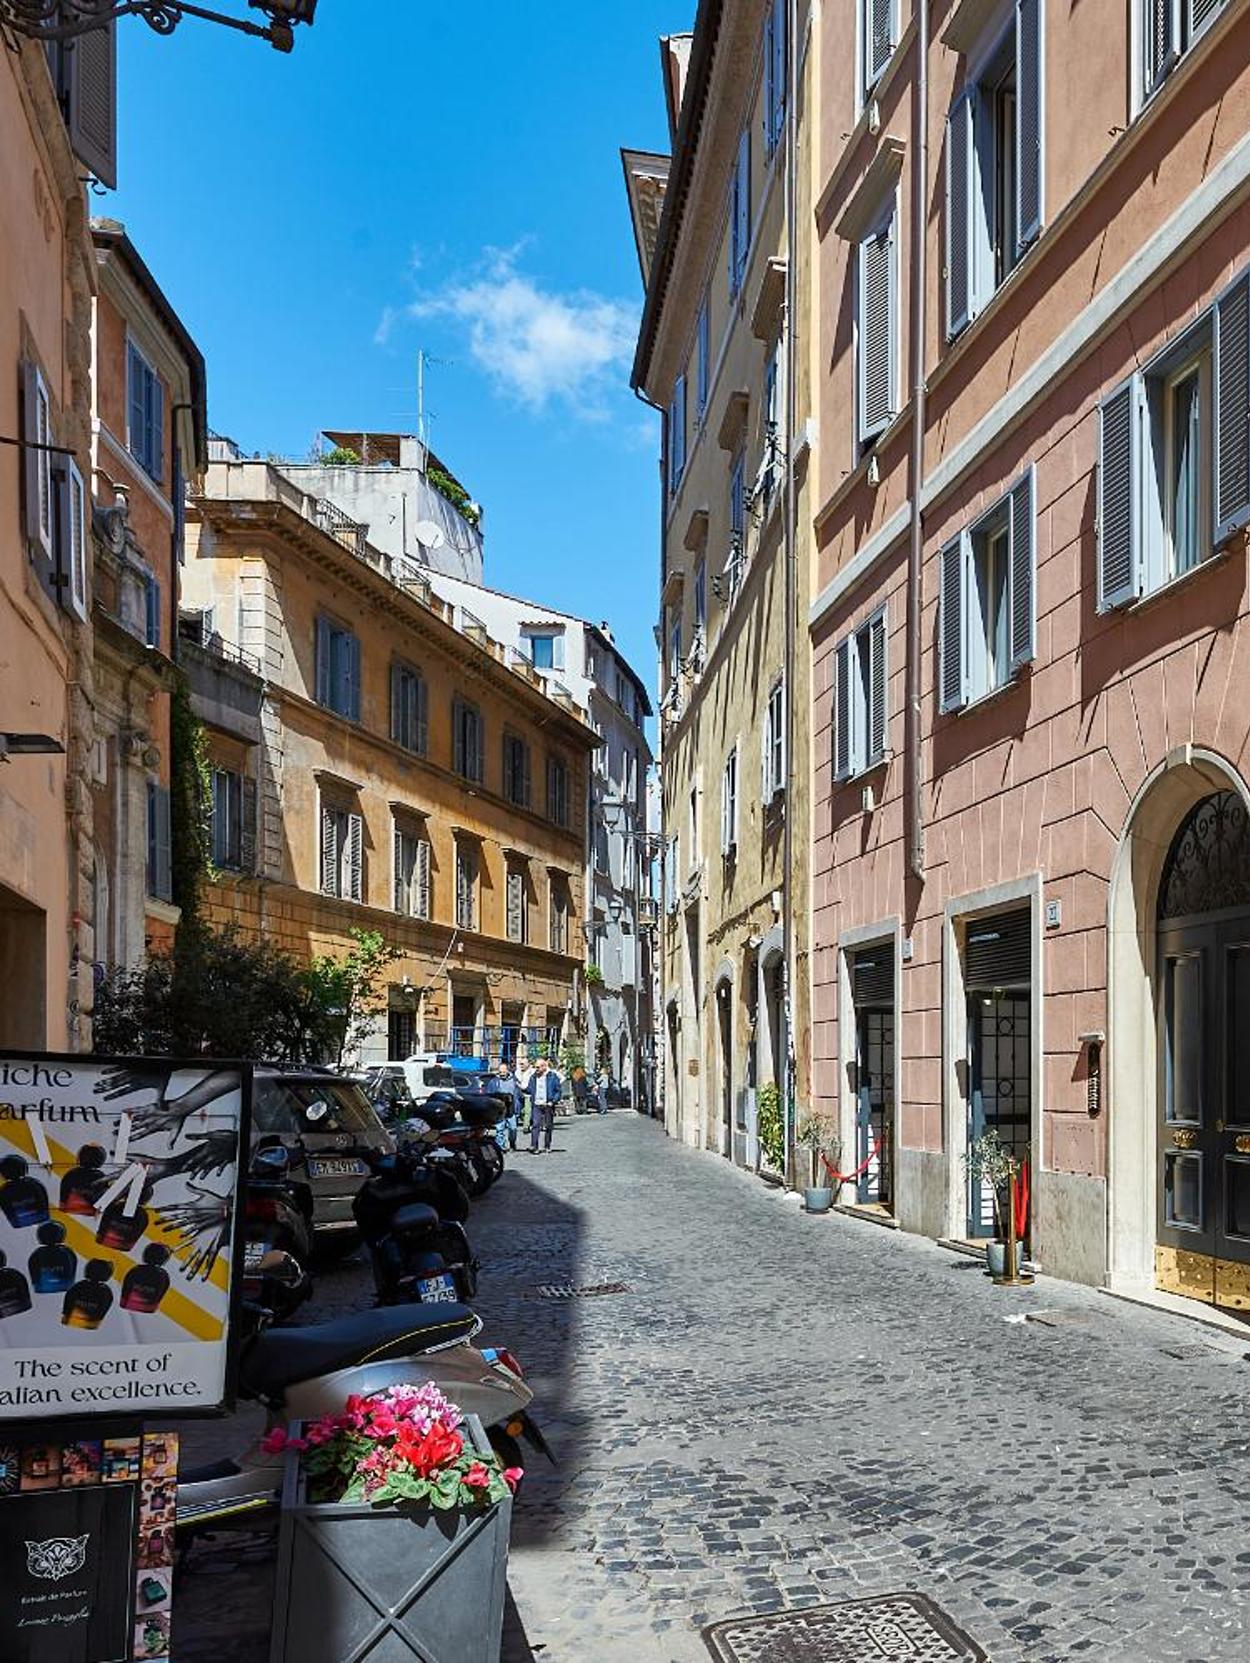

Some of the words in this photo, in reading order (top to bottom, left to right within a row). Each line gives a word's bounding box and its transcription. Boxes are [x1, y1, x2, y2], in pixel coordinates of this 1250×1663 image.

[2, 1063, 74, 1087] iche
[15, 1359, 62, 1378] The
[70, 1359, 138, 1376] scent
[146, 1353, 172, 1372] of
[0, 1386, 62, 1405] alian
[71, 1381, 202, 1402] excellence.
